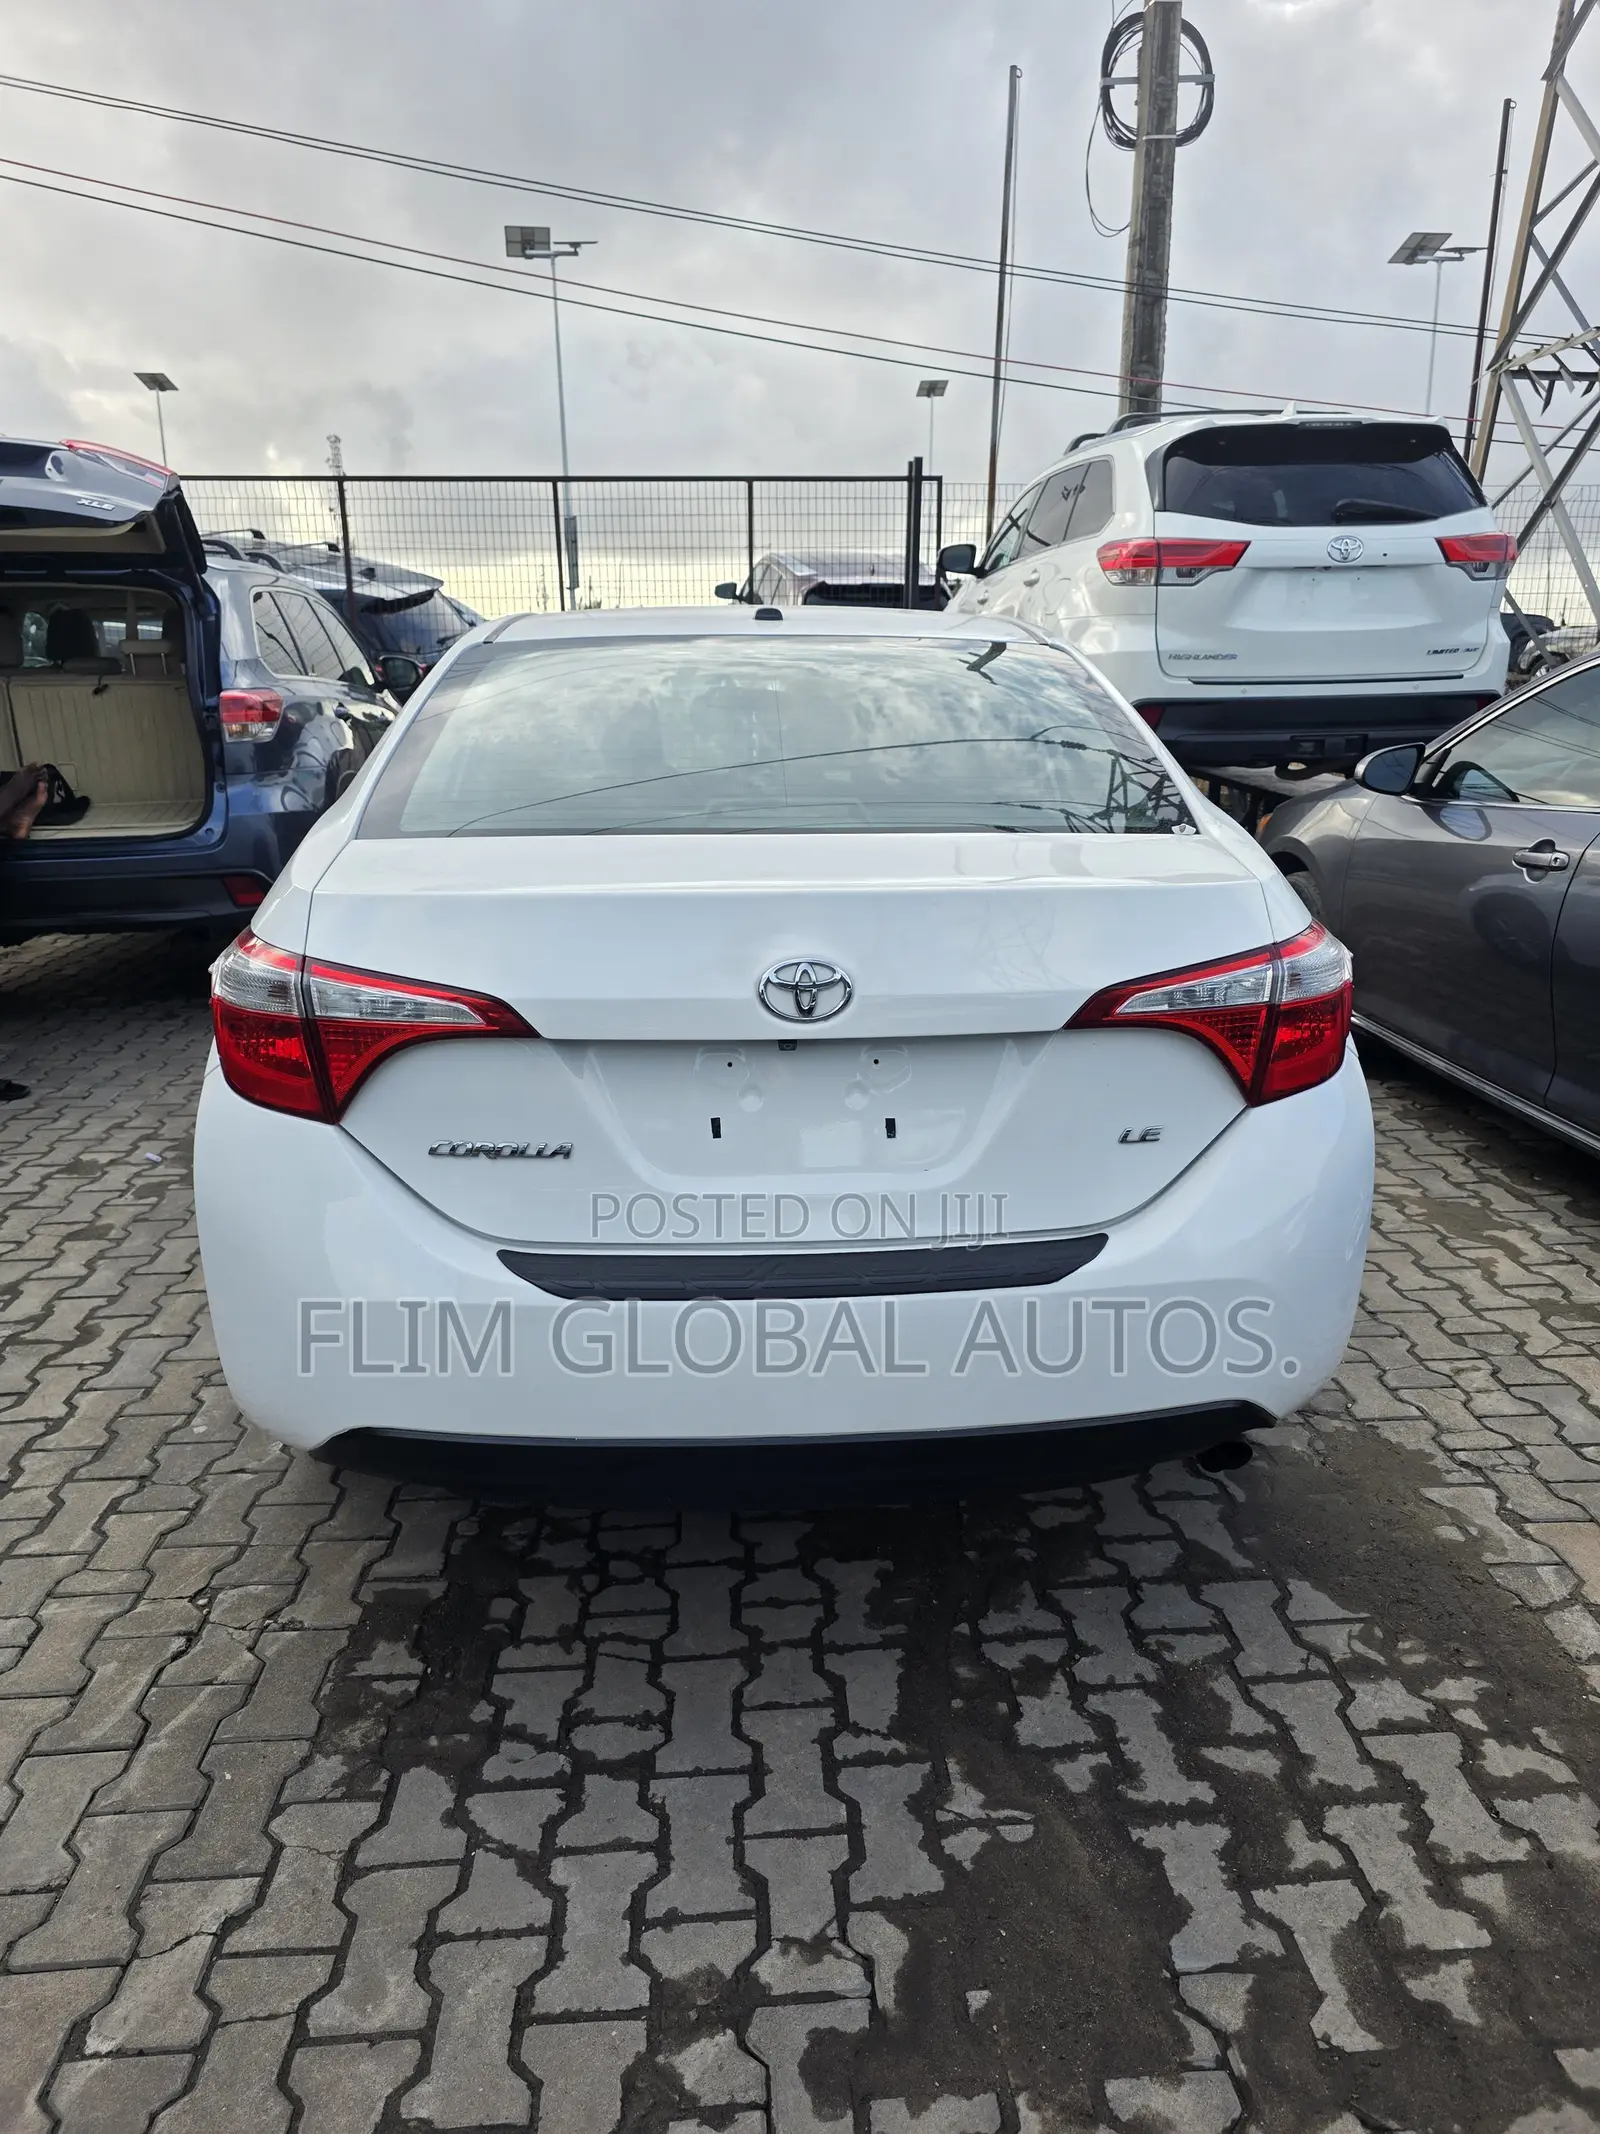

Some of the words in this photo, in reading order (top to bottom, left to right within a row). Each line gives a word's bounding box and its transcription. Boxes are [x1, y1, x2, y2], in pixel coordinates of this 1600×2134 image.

[76, 498, 116, 511] XLE
[1167, 652, 1238, 661] HIGHLANDER
[1117, 1124, 1164, 1144] LE
[428, 1140, 574, 1159] COROLLA
